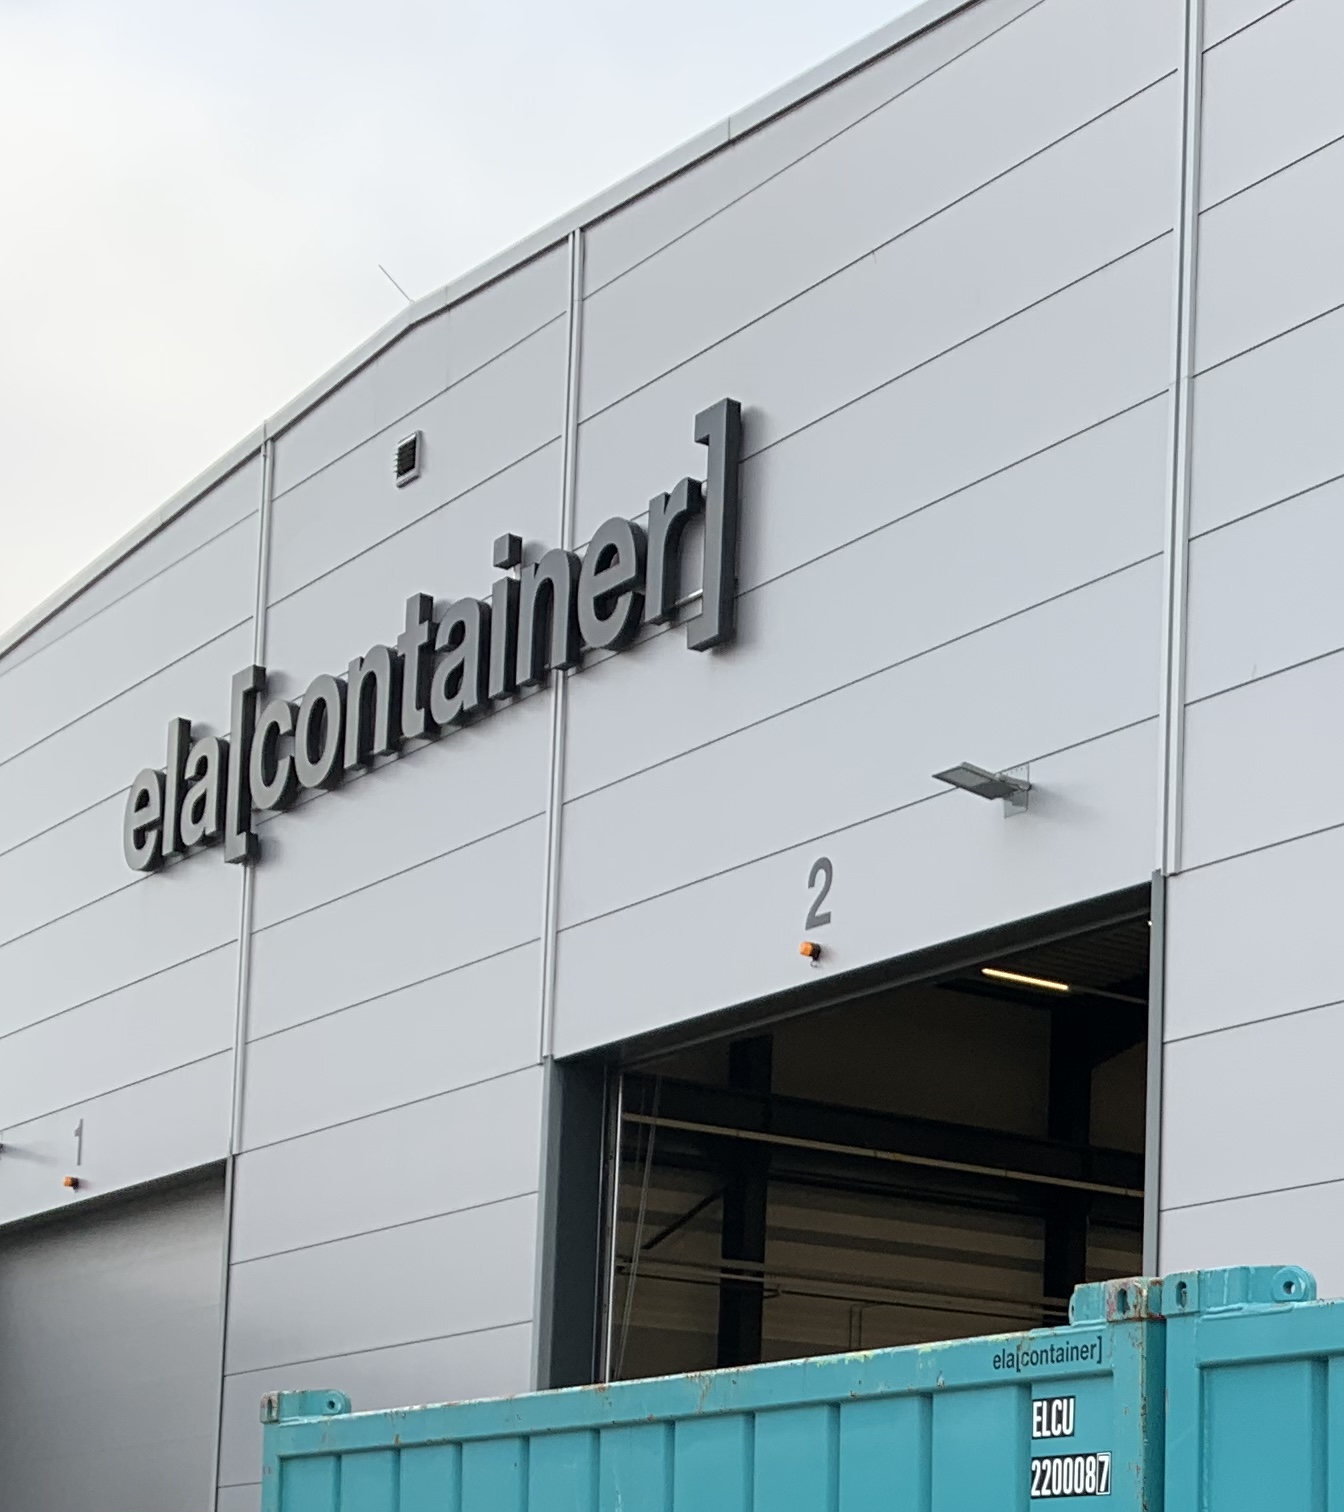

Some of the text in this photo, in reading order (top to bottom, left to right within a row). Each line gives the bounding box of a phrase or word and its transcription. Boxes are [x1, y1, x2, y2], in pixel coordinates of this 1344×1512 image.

[123, 397, 741, 872] ela[container]
[805, 856, 833, 931] 2
[74, 1118, 84, 1166] 1
[992, 1335, 1103, 1373] ela[container]
[1032, 1397, 1075, 1439] ELCU
[1030, 1453, 1112, 1497] 2200087
